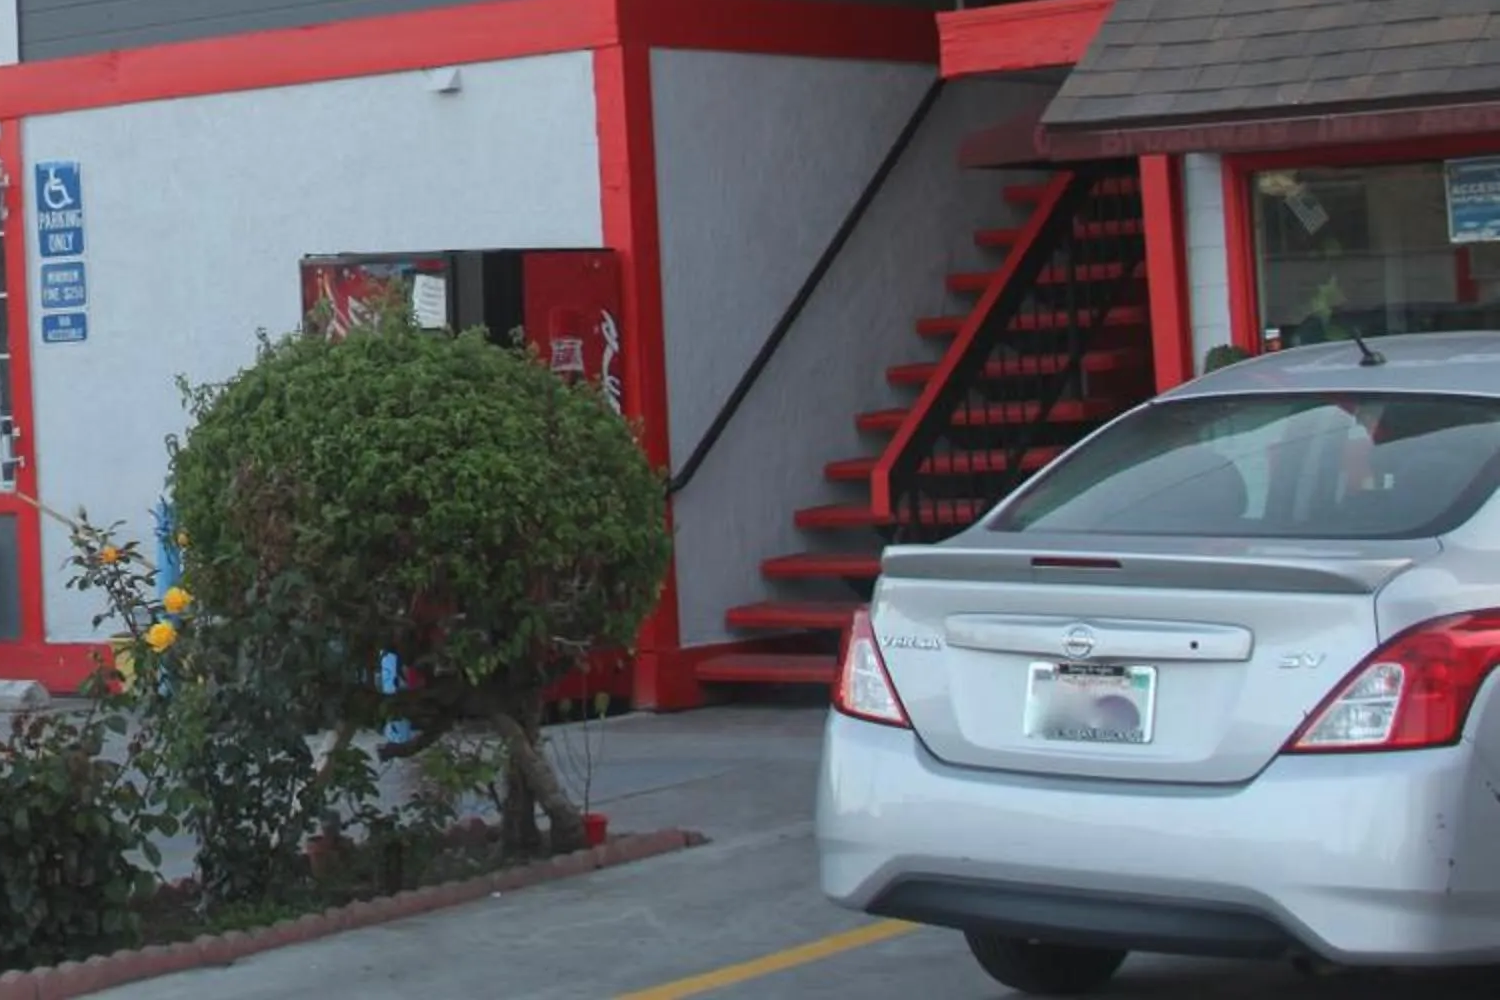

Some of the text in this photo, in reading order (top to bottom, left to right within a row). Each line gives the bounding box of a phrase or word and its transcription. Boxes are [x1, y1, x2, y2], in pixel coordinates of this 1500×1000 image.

[38, 210, 83, 230] PARKING
[49, 232, 74, 252] ONLY
[881, 634, 942, 652] VERSA
[1278, 650, 1327, 670] SV
